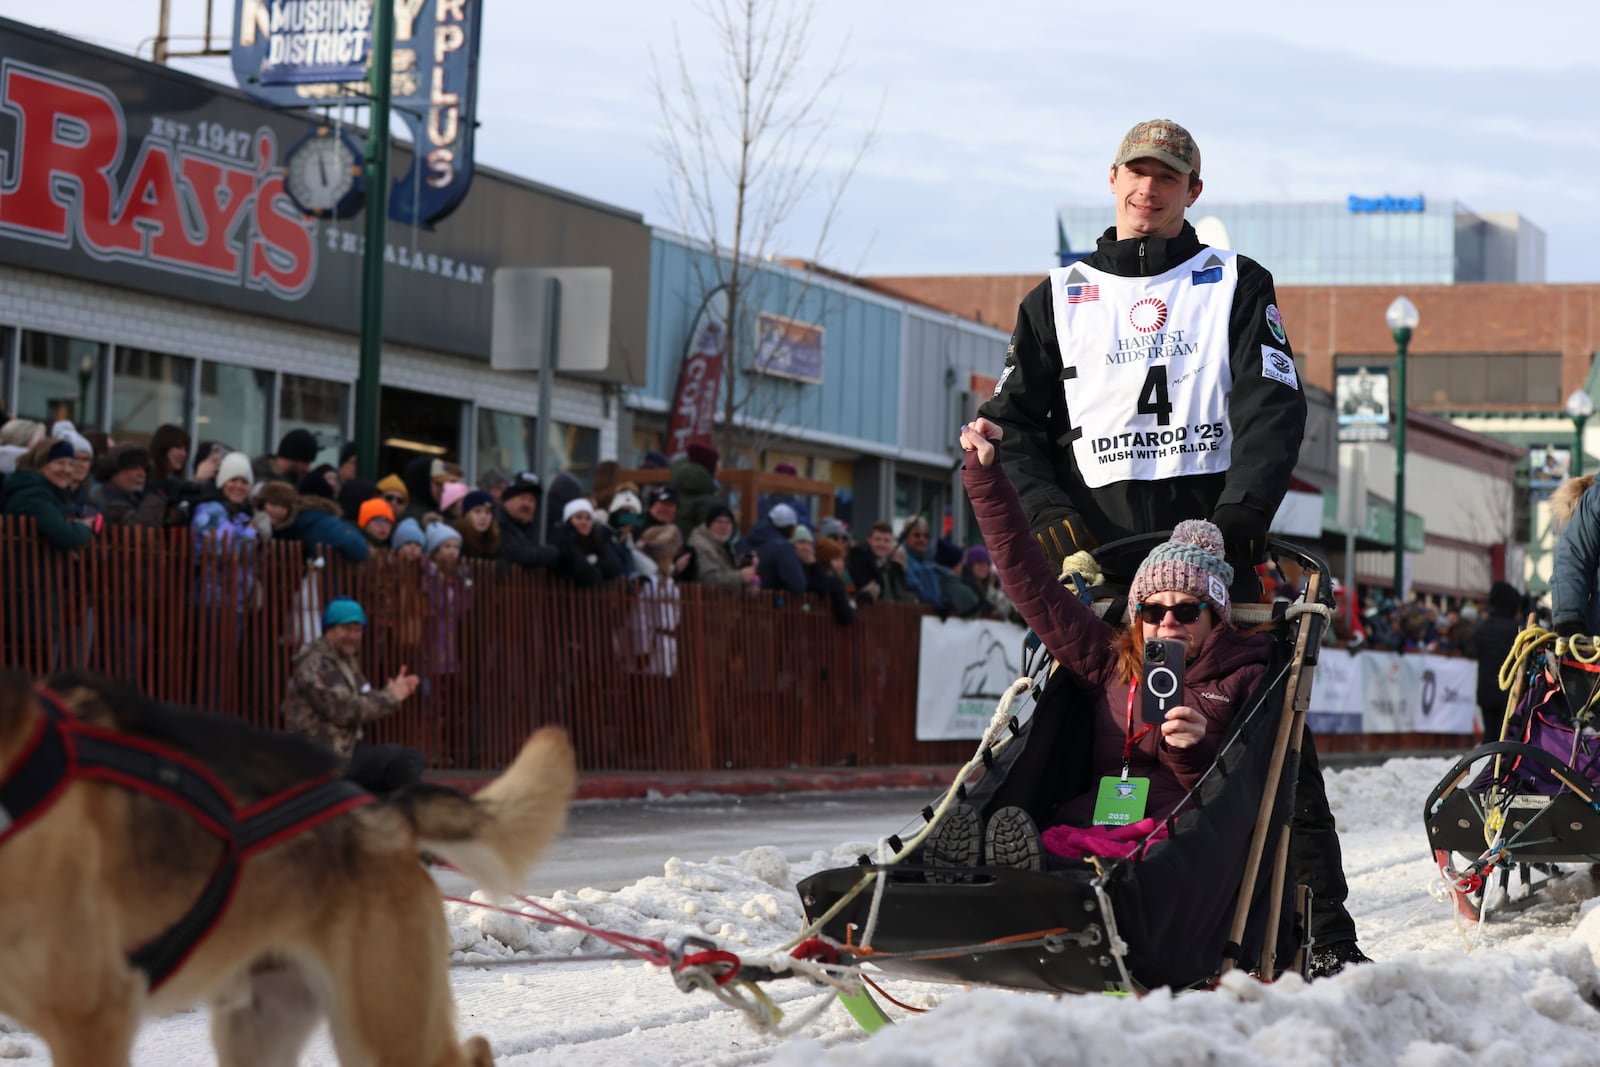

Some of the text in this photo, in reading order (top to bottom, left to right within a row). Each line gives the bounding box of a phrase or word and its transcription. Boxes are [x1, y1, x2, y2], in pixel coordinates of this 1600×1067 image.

[271, 0, 371, 33] MUSHING
[269, 33, 367, 65] DISTRICT
[197, 121, 251, 160] 1947
[0, 62, 316, 297] RAY'S
[383, 244, 484, 284] ALASKAN
[1105, 342, 1199, 366] MIDSTREAM
[1117, 330, 1185, 351] HARVEST
[1137, 364, 1172, 426] 4
[1091, 426, 1187, 454] IDITAROD
[1098, 441, 1220, 464] MUSH WITH P.R.I.D.E.
